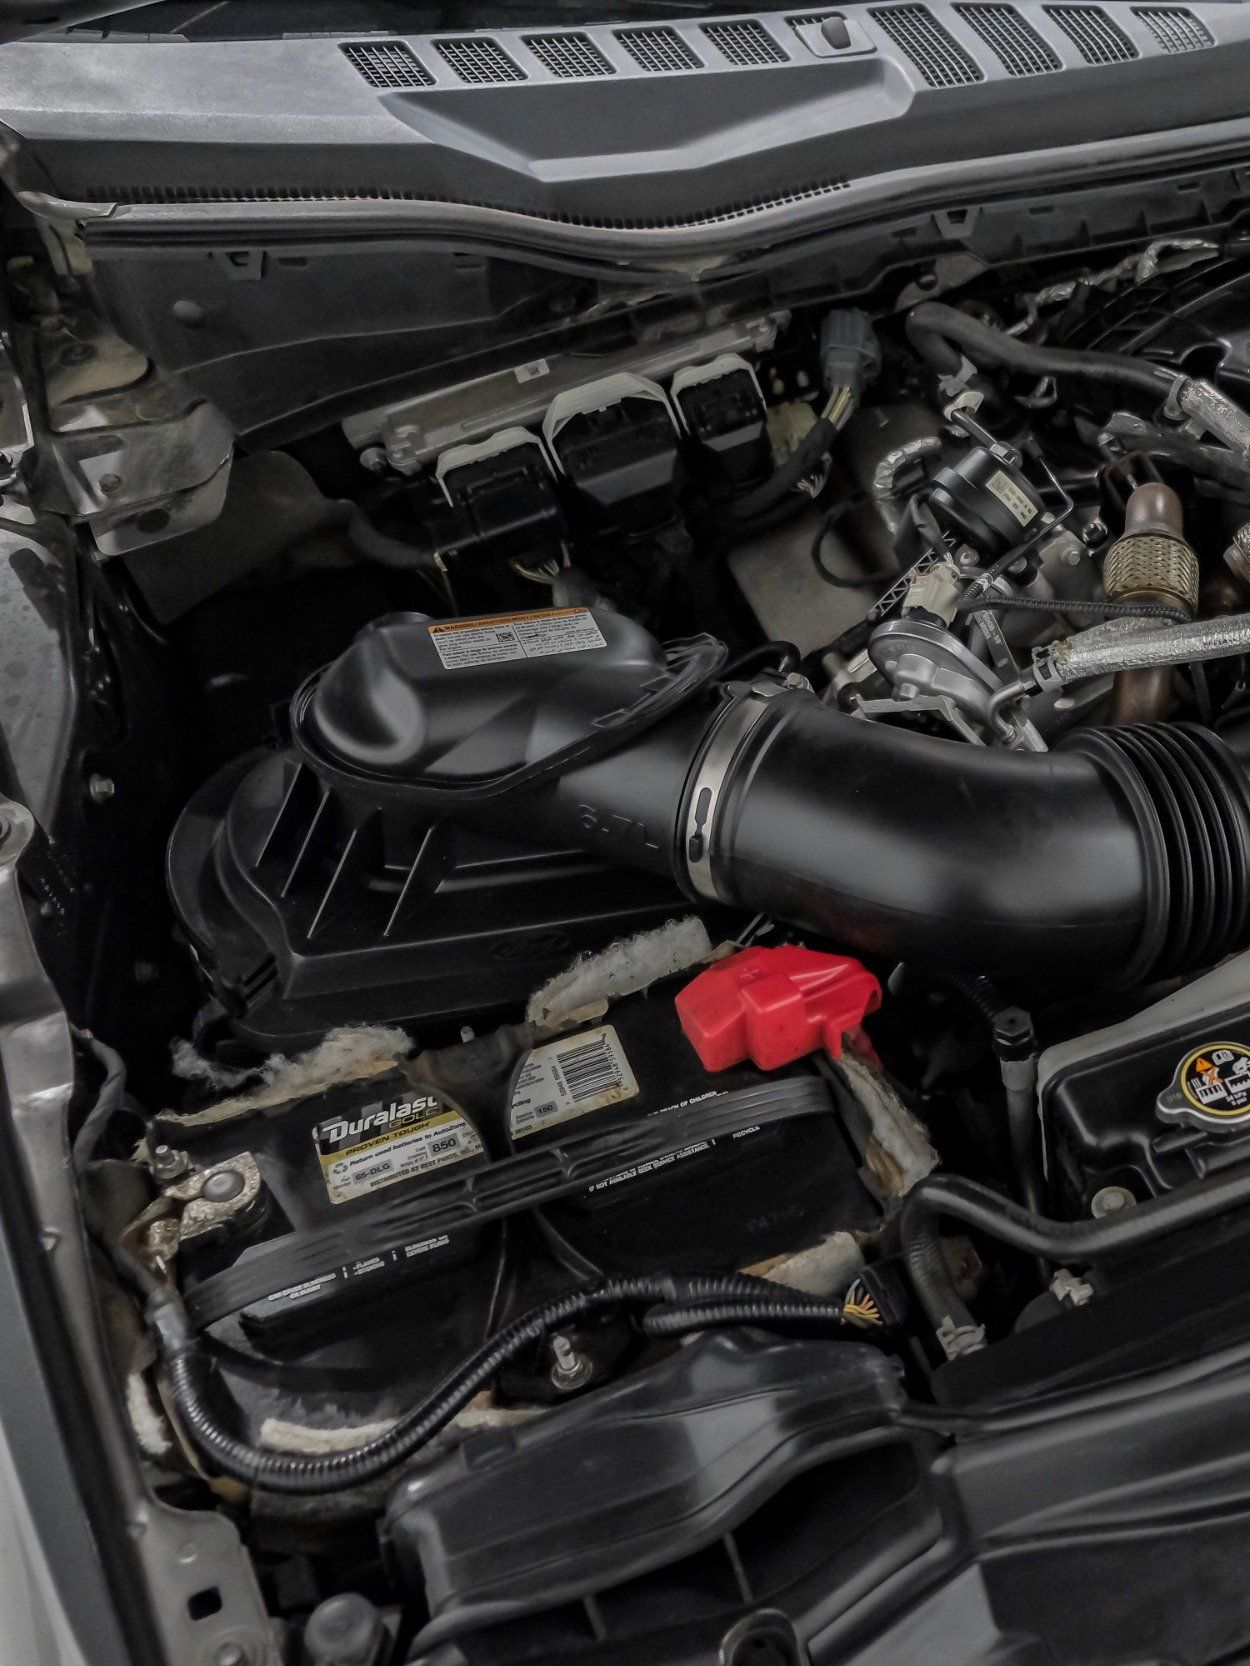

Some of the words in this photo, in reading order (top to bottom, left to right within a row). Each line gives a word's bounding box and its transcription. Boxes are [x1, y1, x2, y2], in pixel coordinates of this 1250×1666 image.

[322, 1096, 438, 1143] Duralast
[345, 1135, 390, 1156] PROVEN
[393, 1121, 431, 1139] TOUGH
[349, 1153, 373, 1167] Return
[375, 1146, 392, 1157] used
[392, 1136, 423, 1150] batteries
[433, 1122, 467, 1137] AutoZone
[432, 1138, 457, 1153] 850
[355, 1162, 391, 1182] 65-DLG
